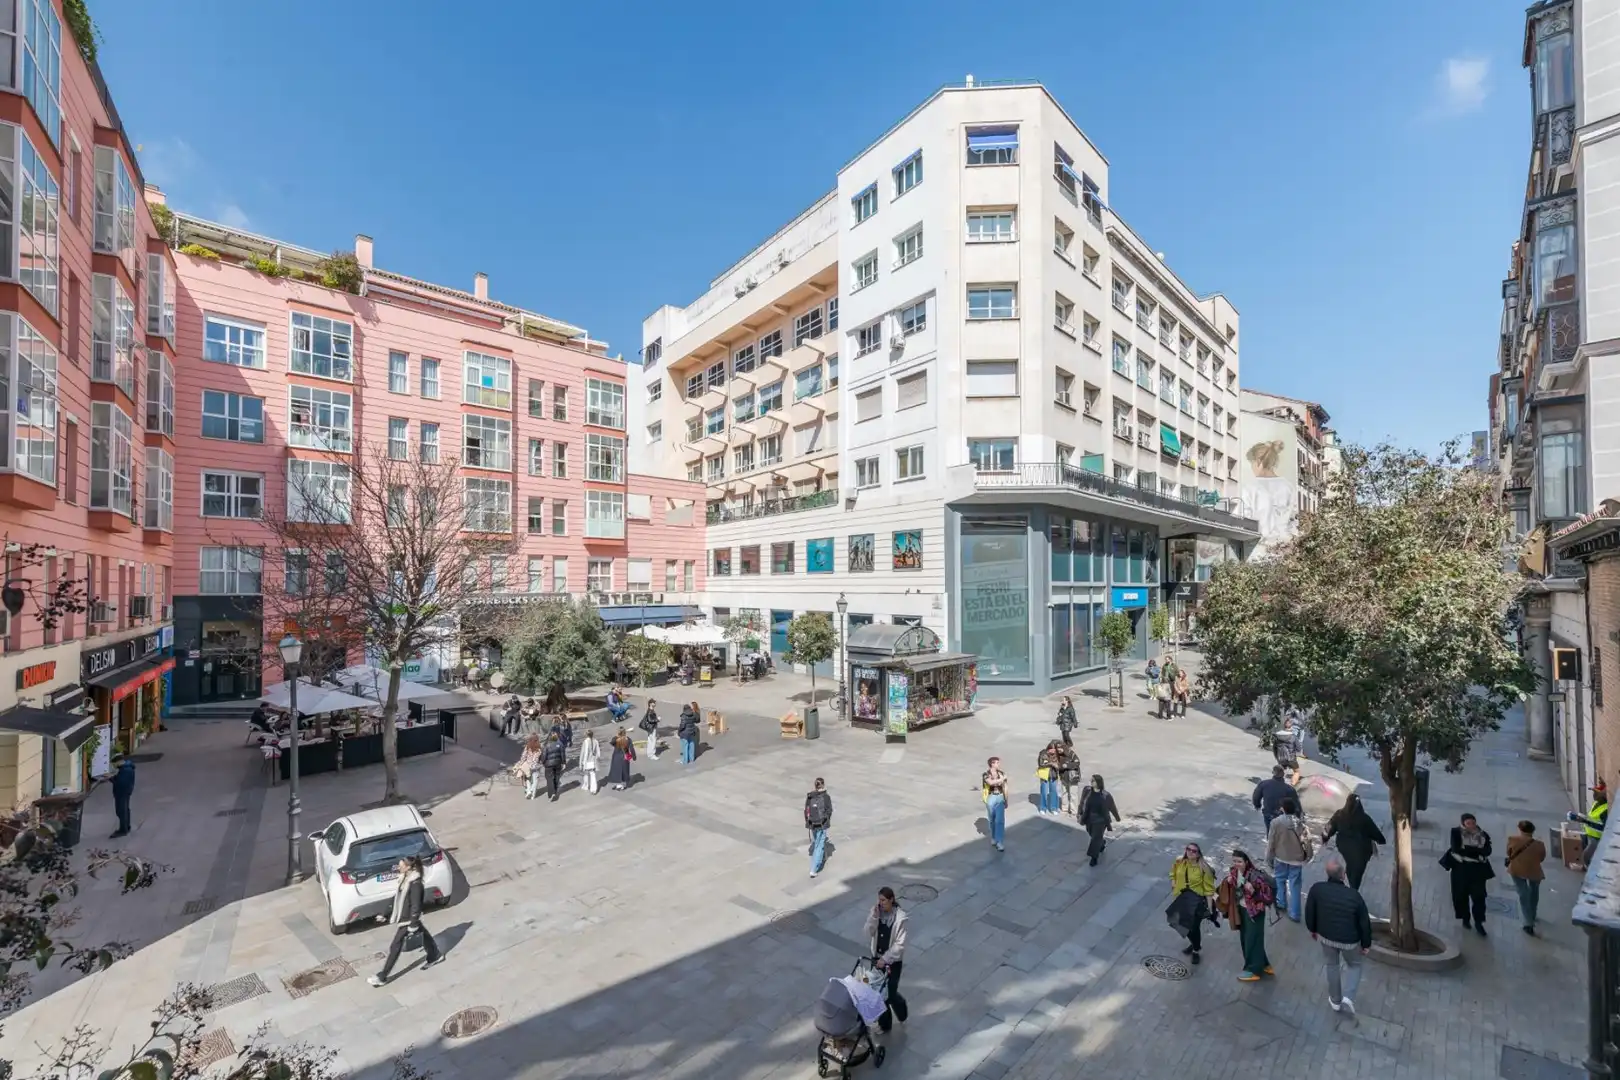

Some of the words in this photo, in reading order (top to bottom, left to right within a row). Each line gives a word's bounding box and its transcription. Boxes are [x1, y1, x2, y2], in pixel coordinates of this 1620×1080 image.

[995, 593, 1010, 607] EN
[1012, 592, 1026, 606] EL
[966, 606, 1025, 623] MERCADO
